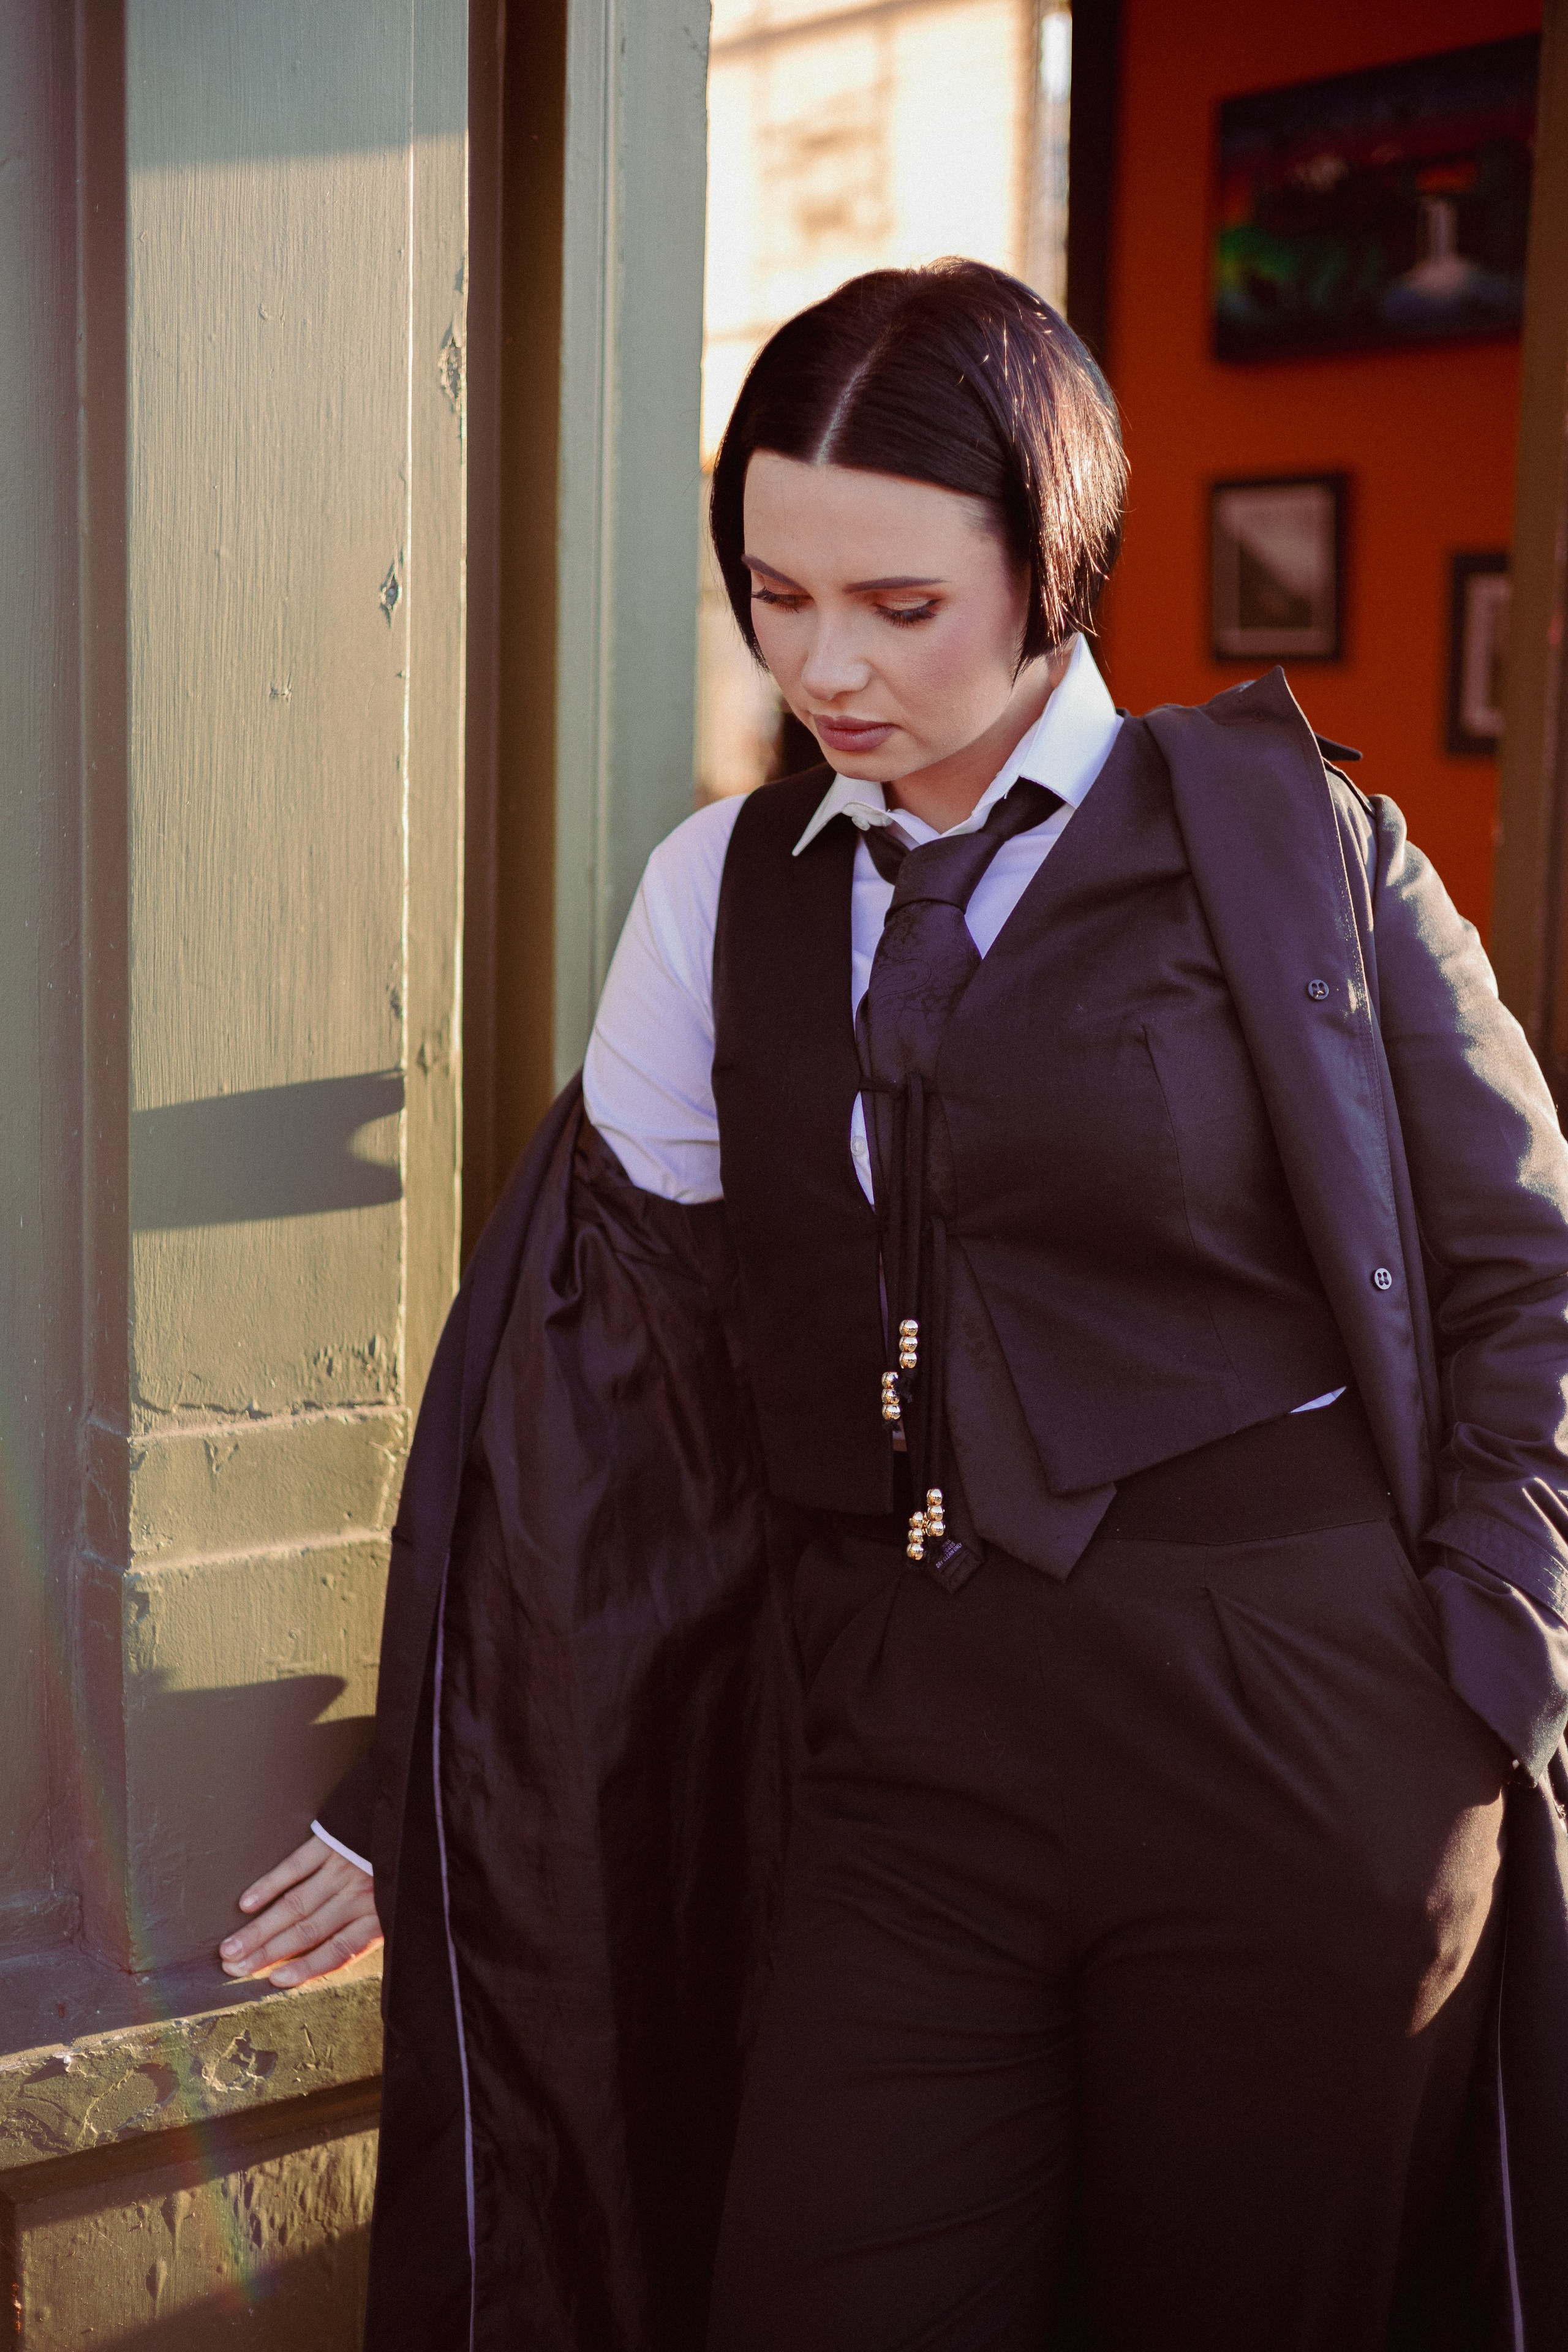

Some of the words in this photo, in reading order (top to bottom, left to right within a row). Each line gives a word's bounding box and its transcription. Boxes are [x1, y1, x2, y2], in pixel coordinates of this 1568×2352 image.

[941, 1539, 951, 1548] HINA
[943, 1549, 955, 1562] CLEAN
[953, 1542, 962, 1552] ONLY
